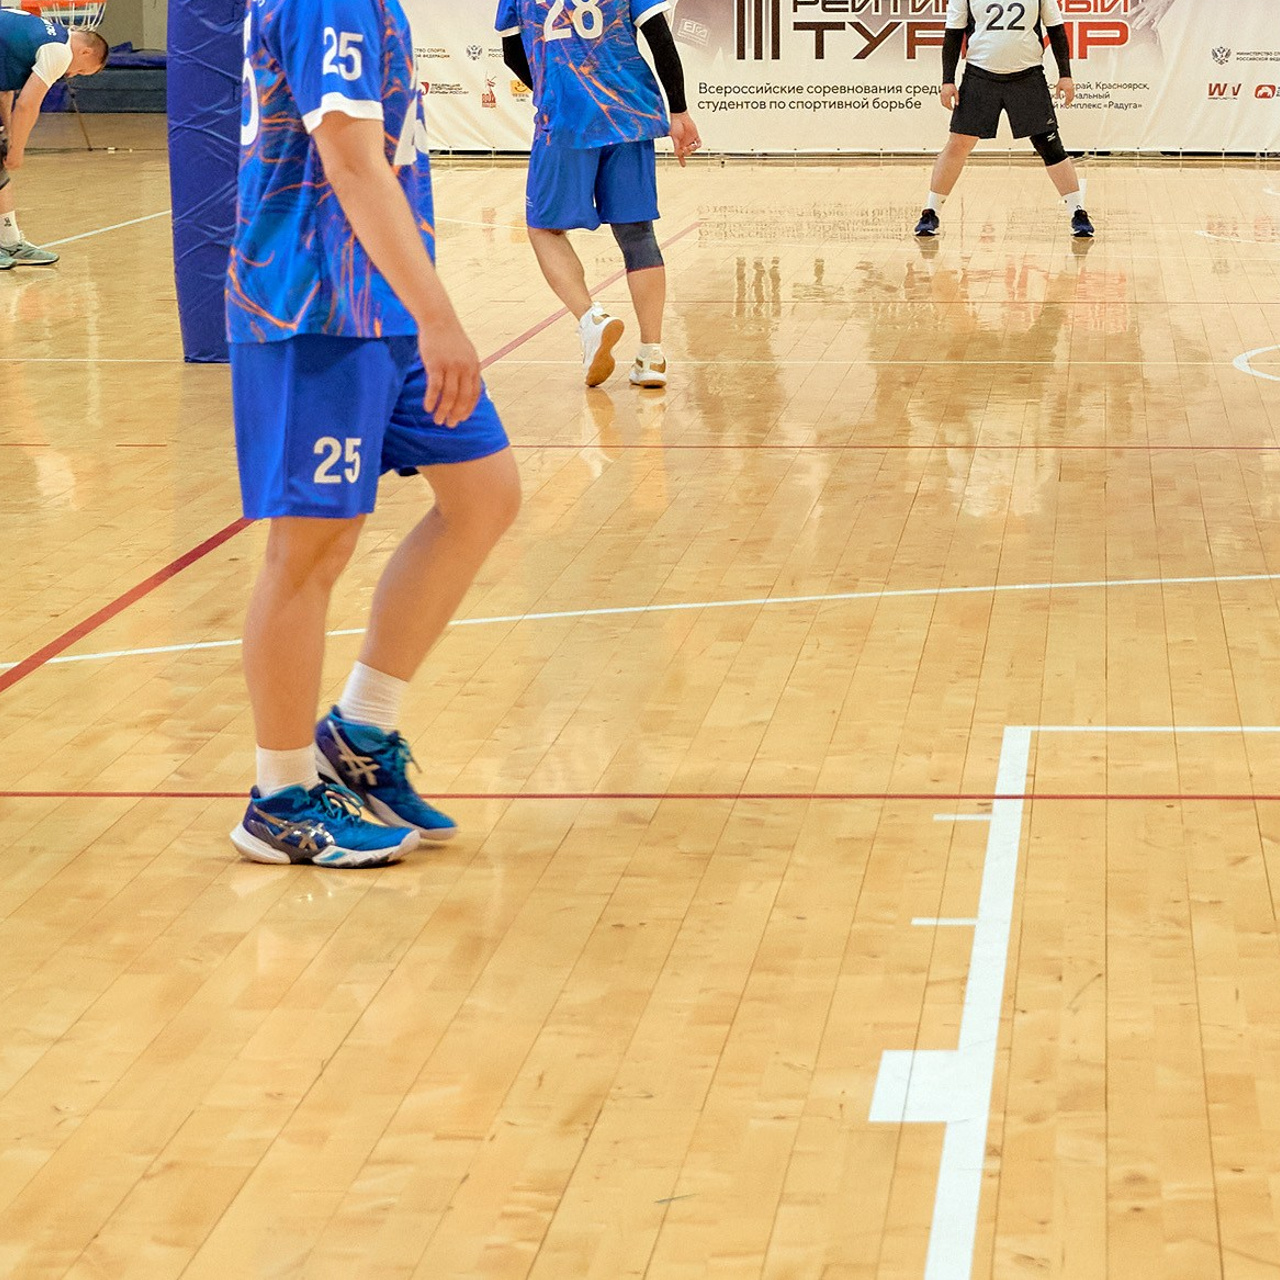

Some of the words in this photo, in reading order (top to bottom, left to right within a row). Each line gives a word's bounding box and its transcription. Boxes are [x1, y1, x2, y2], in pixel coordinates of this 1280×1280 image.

[985, 2, 1026, 31] 22
[321, 26, 364, 81] 25
[698, 81, 804, 97] Всероссийские
[806, 84, 902, 97] соревнования
[1095, 81, 1150, 92] Красноярск,
[698, 99, 767, 112] студентов
[769, 100, 786, 109] по
[788, 96, 869, 112] спортивной
[872, 96, 921, 111] борьбе
[313, 436, 362, 485] 25
